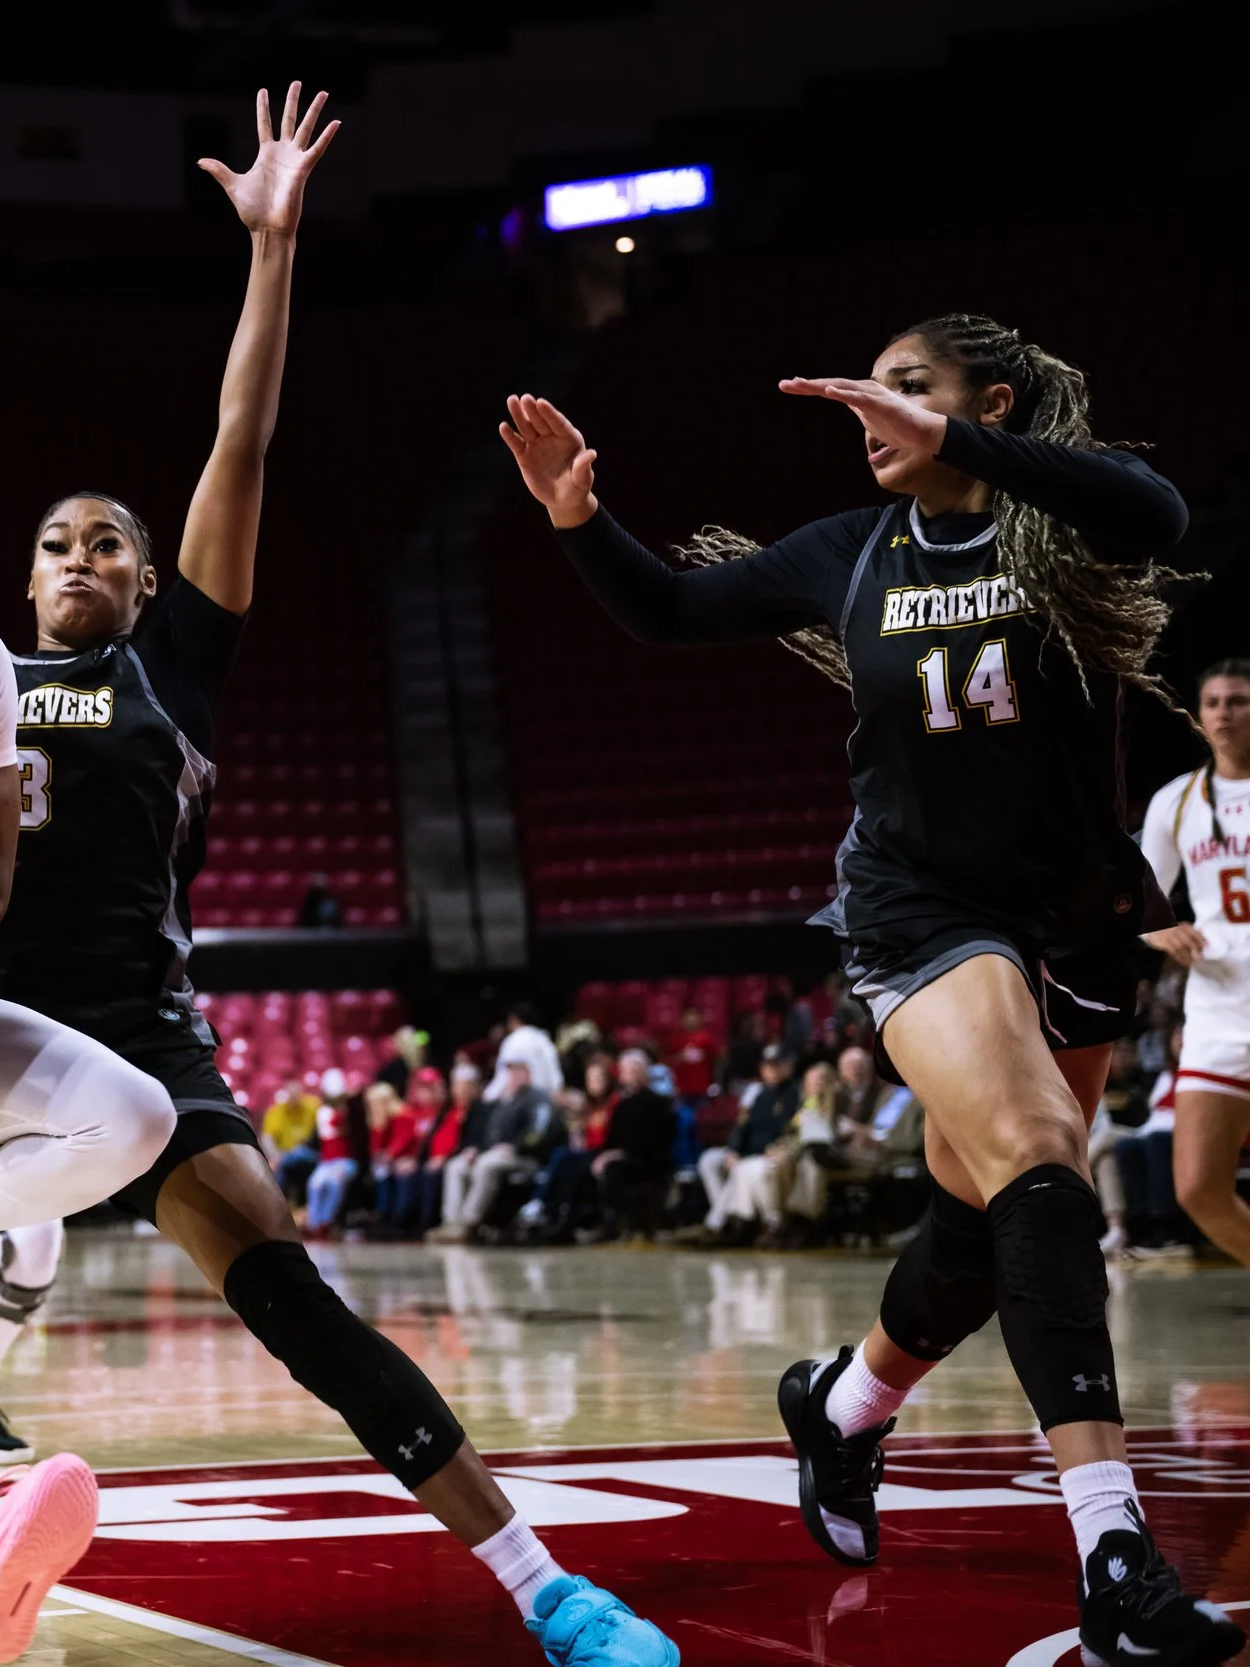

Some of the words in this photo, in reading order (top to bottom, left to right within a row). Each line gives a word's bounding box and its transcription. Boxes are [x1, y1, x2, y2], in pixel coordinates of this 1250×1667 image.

[881, 574, 1036, 635] RETRIEVER
[17, 684, 113, 727] IEVERS
[917, 638, 1020, 733] 14
[18, 746, 52, 831] 3
[1219, 867, 1250, 924] 6
